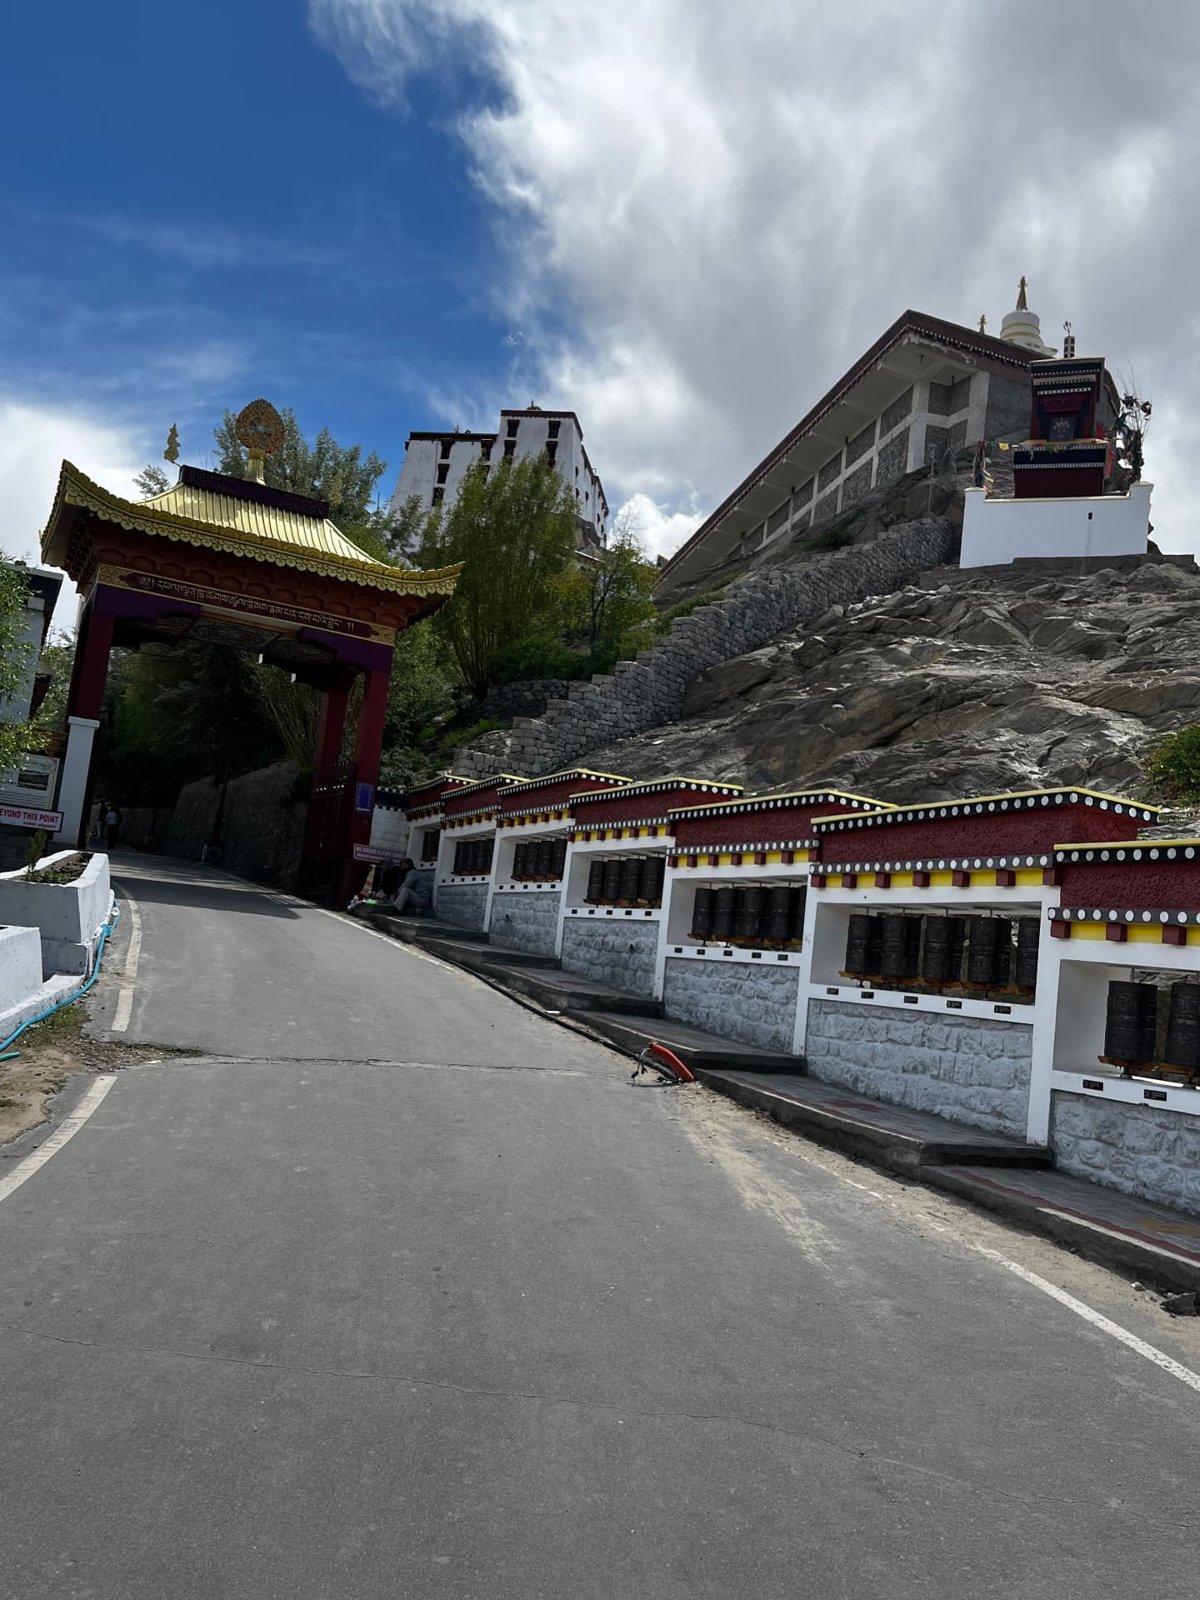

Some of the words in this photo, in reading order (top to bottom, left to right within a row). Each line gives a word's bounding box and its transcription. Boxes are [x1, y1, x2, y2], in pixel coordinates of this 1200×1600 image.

[0, 808, 21, 818] EYOND
[23, 812, 38, 821] THIS
[39, 814, 59, 824] POINT
